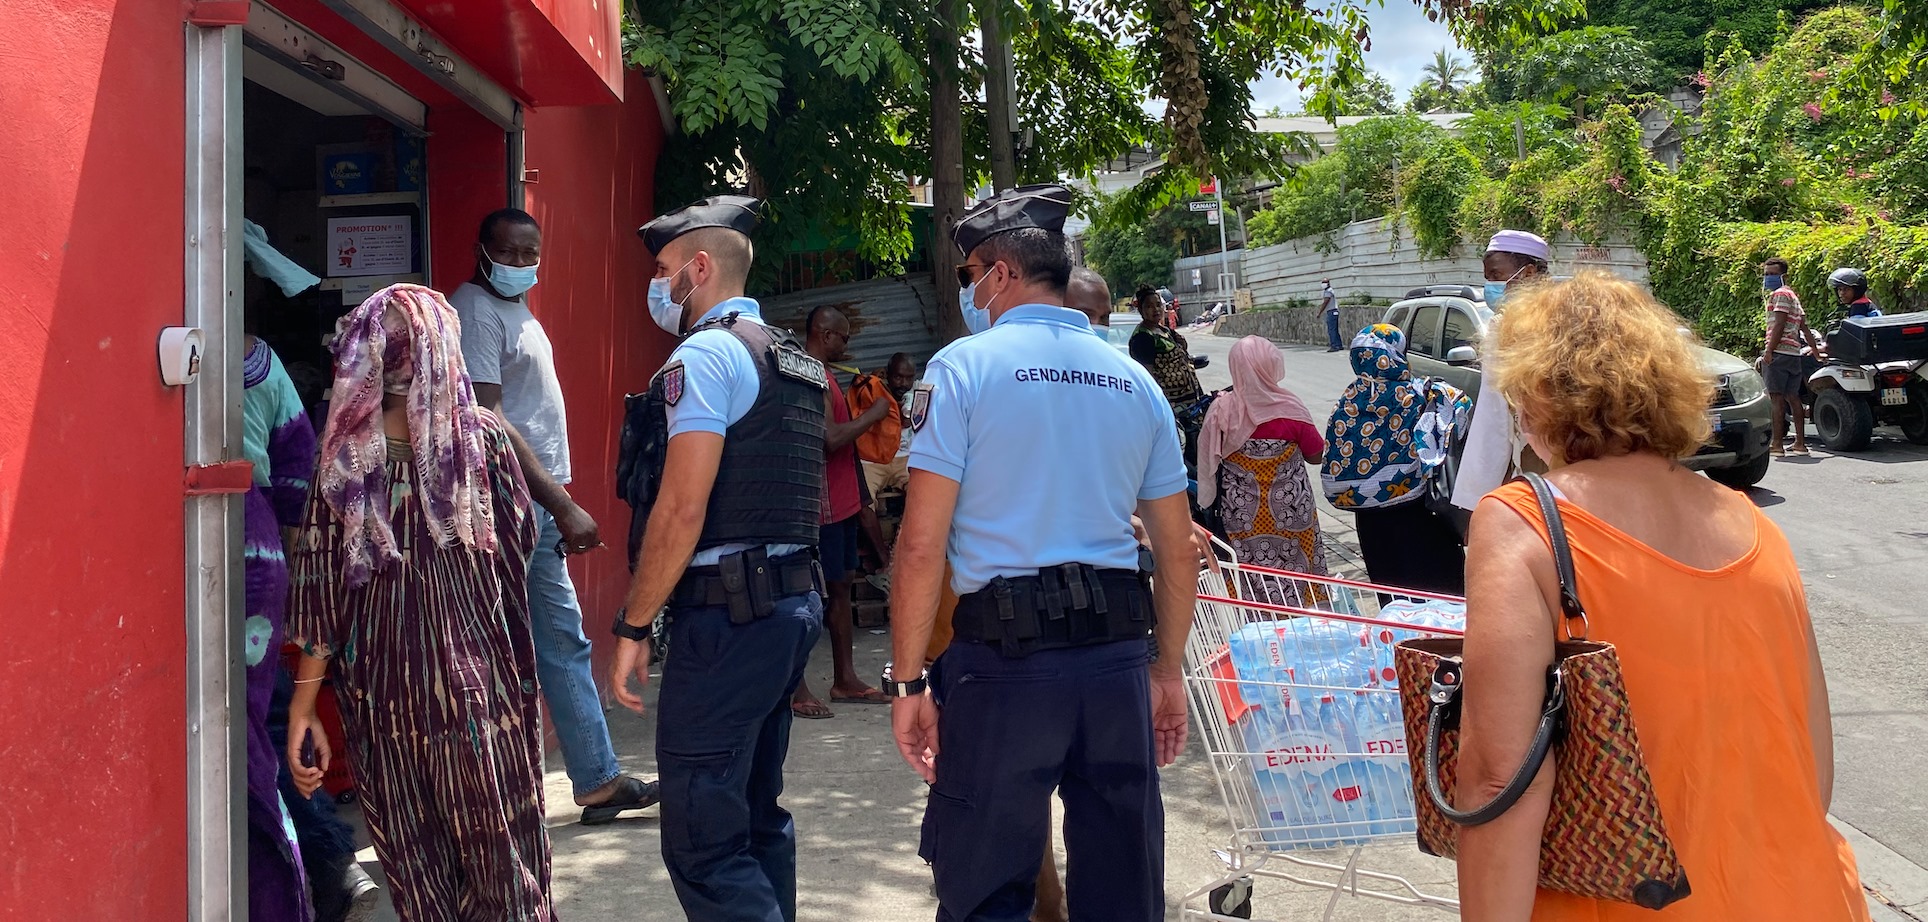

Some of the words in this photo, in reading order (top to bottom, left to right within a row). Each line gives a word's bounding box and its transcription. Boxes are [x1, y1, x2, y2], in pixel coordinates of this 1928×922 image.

[1015, 368, 1133, 393] GENDARMERIE
[1265, 744, 1336, 768] EDENA
[1366, 739, 1404, 758] EDE
